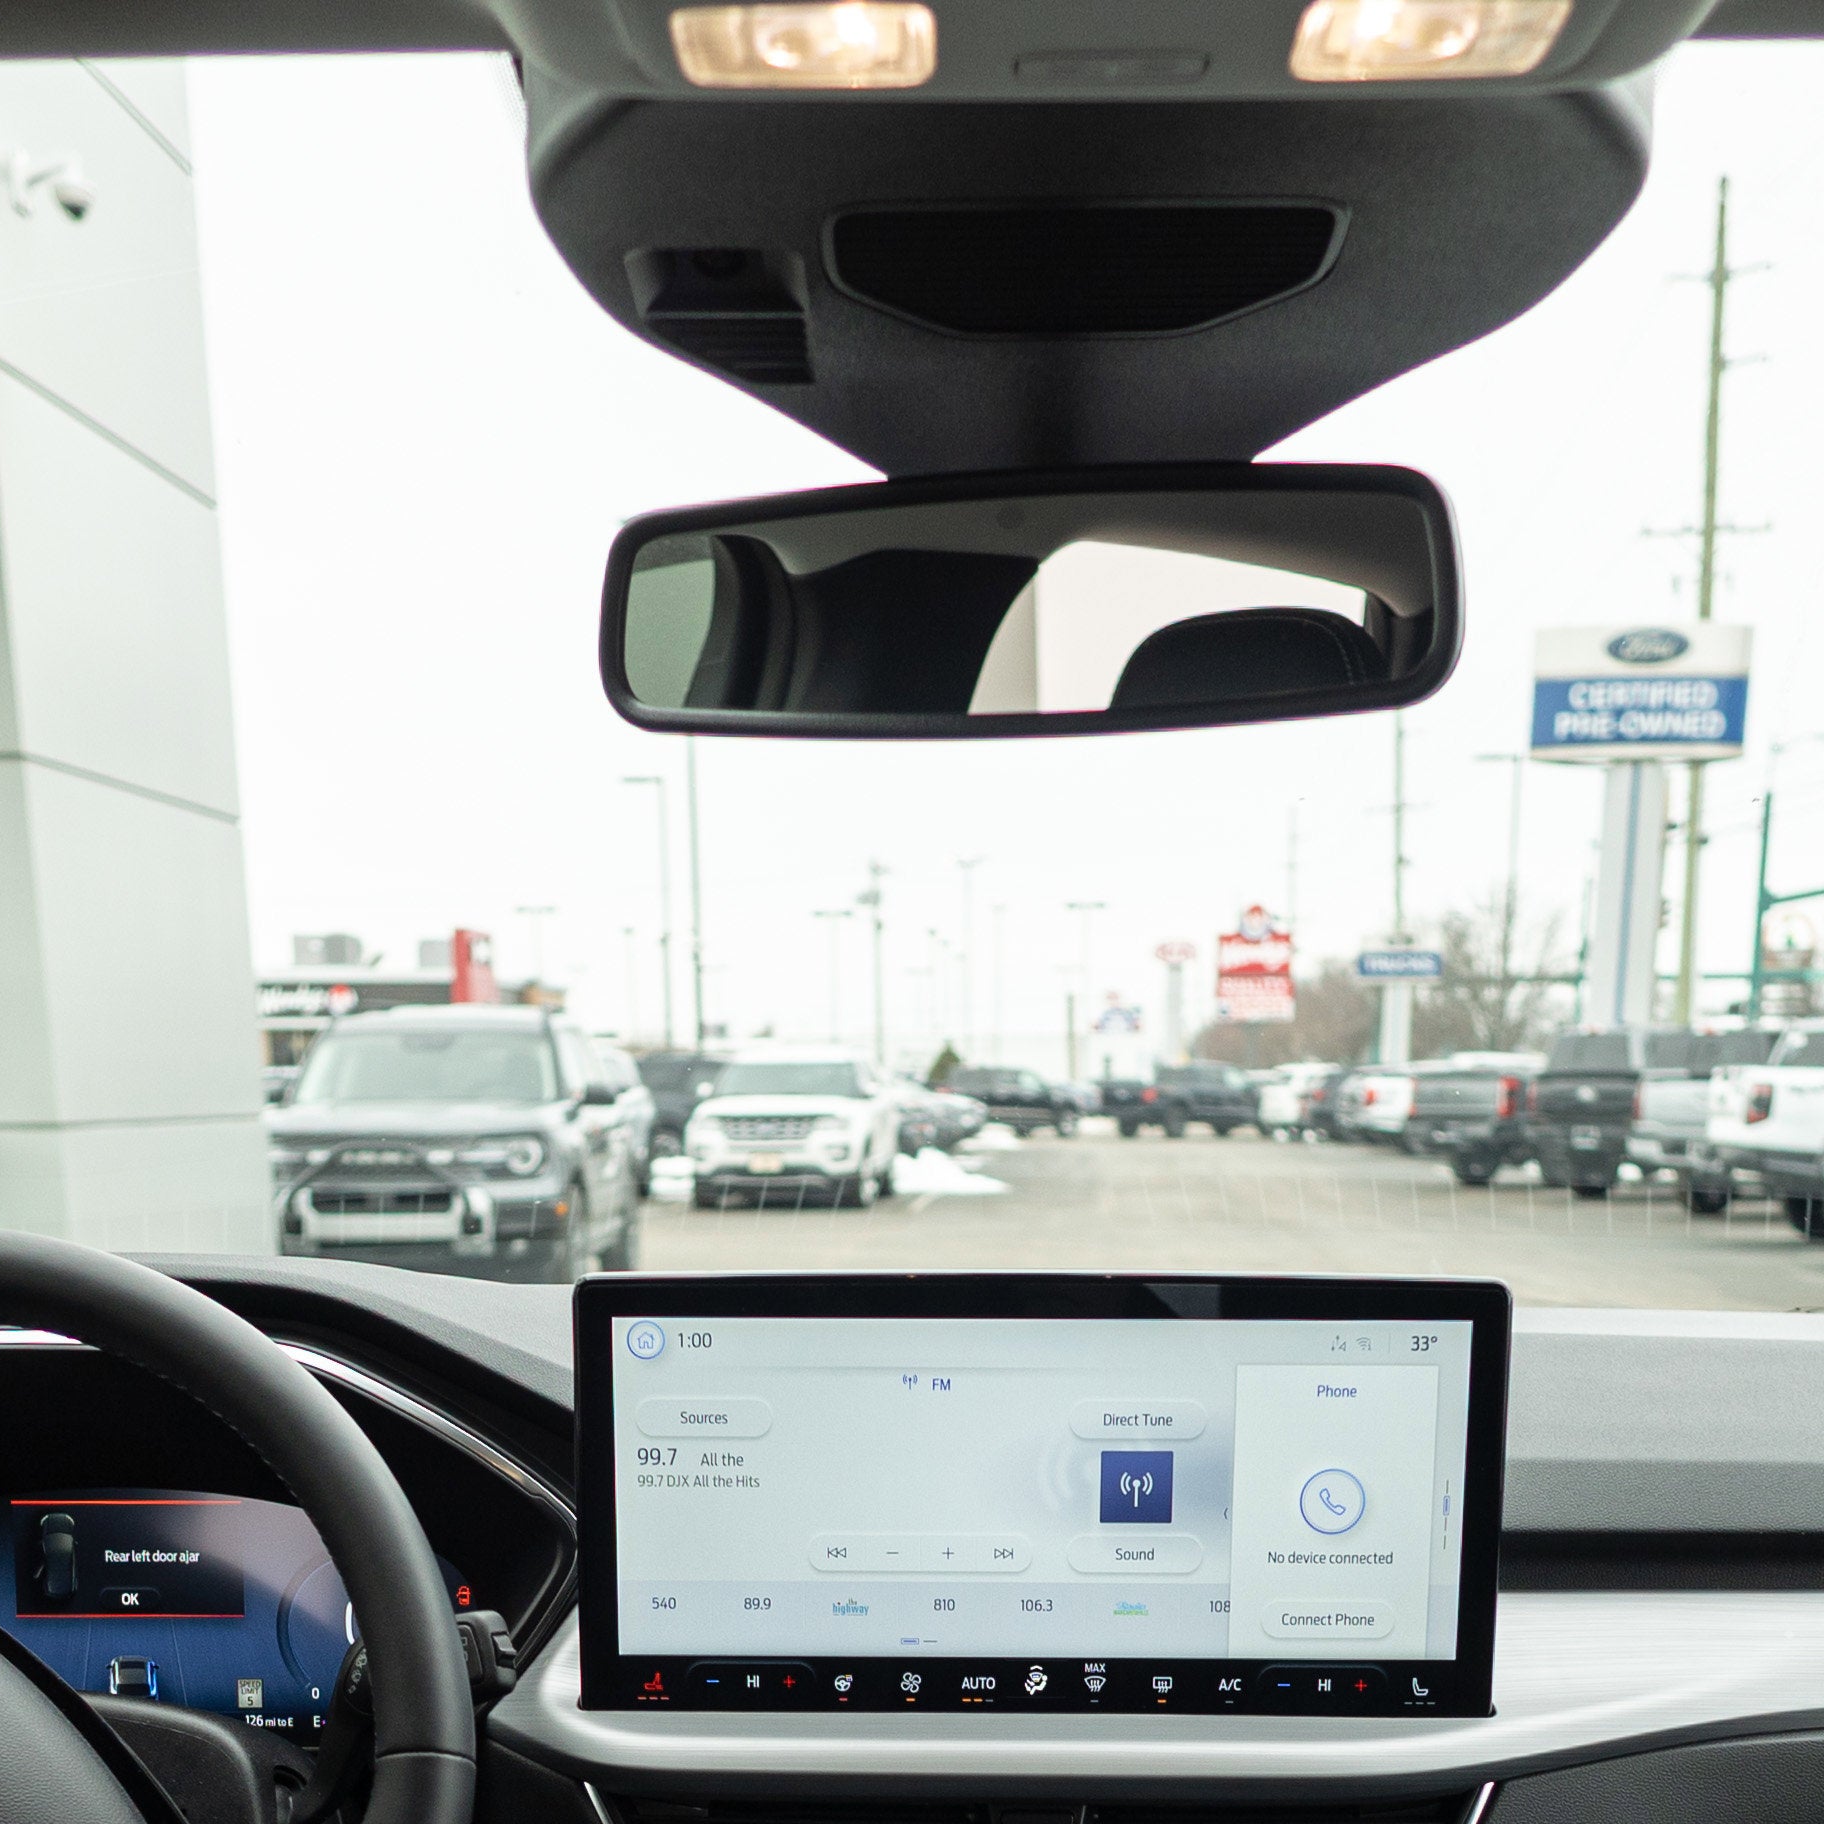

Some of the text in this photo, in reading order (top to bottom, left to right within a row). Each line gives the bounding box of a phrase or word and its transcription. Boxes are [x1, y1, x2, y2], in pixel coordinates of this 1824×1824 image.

[1568, 681, 1718, 709] CERTIFIED
[1555, 710, 1726, 740] PRE-OWNED
[677, 1333, 713, 1349] 1:00
[1410, 1335, 1438, 1352] 33°
[932, 1379, 952, 1392] FM
[1316, 1385, 1357, 1399] Phone
[680, 1411, 728, 1426] Sources
[1103, 1413, 1173, 1427] Direct Tune
[637, 1448, 677, 1466] 99.7
[700, 1453, 744, 1467] All the
[637, 1475, 760, 1488] 99.7 DJX All the Hits
[104, 1549, 200, 1565] Rear left door ajar
[1115, 1548, 1155, 1562] Sound
[1267, 1552, 1393, 1565] No device connected
[121, 1592, 139, 1606] OK
[651, 1597, 677, 1610] 540
[743, 1597, 772, 1610] 89.9
[933, 1599, 956, 1612] 810
[1019, 1599, 1054, 1612] 106.3
[1281, 1613, 1375, 1627] Connect Phone
[1084, 1663, 1106, 1673] MAX
[239, 1680, 262, 1688] SPEED
[746, 1674, 760, 1689] HI
[961, 1676, 996, 1690] AUTO
[1218, 1679, 1242, 1692] A/C
[1317, 1679, 1331, 1691] HI
[240, 1687, 259, 1695] LIMIT
[311, 1687, 320, 1700] 0
[247, 1695, 254, 1706] 5
[245, 1714, 294, 1727] 126 mi to E
[313, 1715, 321, 1728] E
